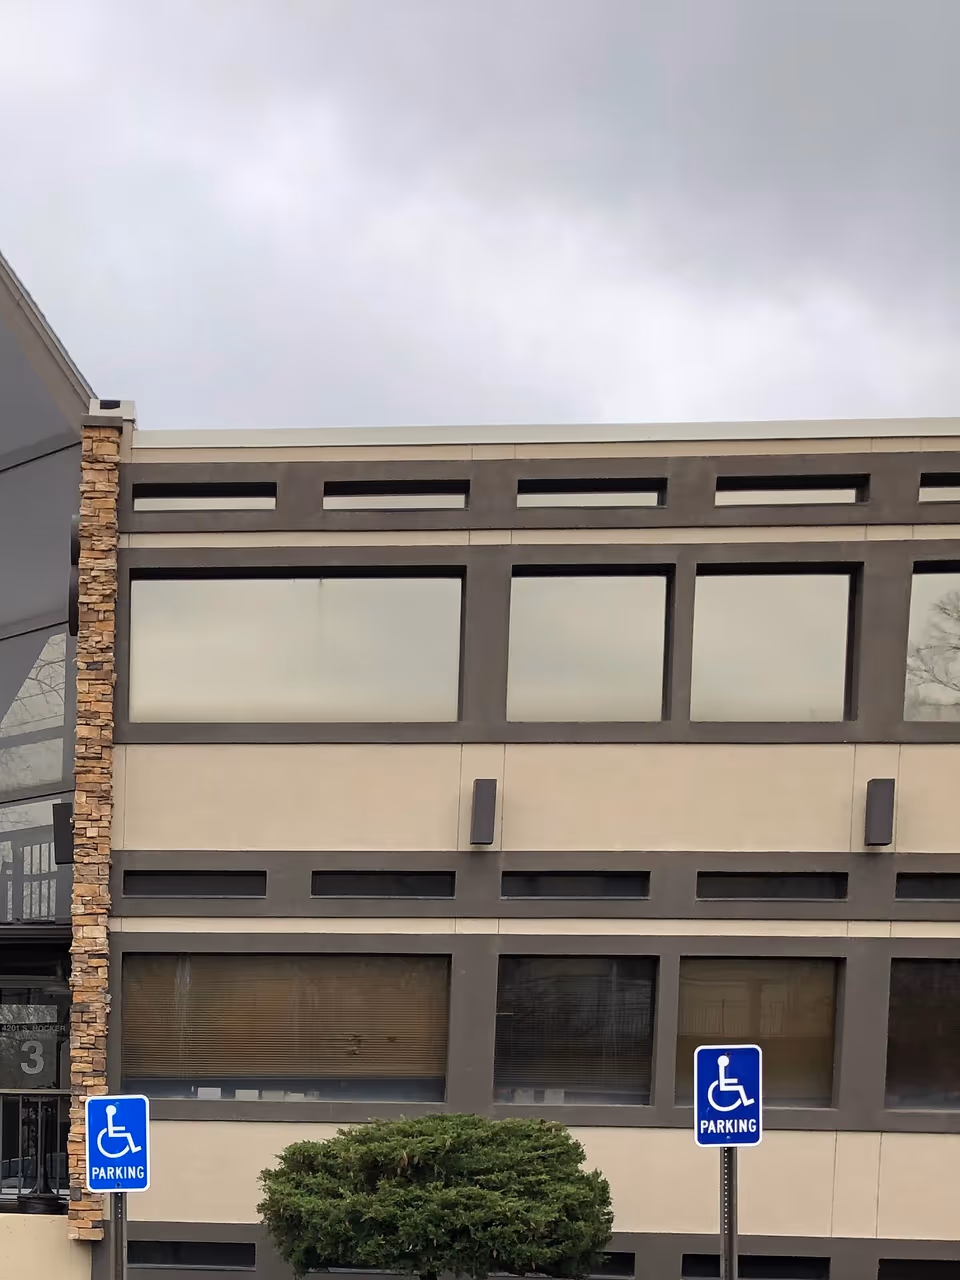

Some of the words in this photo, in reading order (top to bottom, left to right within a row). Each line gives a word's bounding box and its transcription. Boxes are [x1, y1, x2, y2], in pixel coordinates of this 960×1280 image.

[20, 1040, 45, 1075] 3
[701, 1119, 757, 1134] PARKING
[92, 1166, 144, 1180] PARKING
